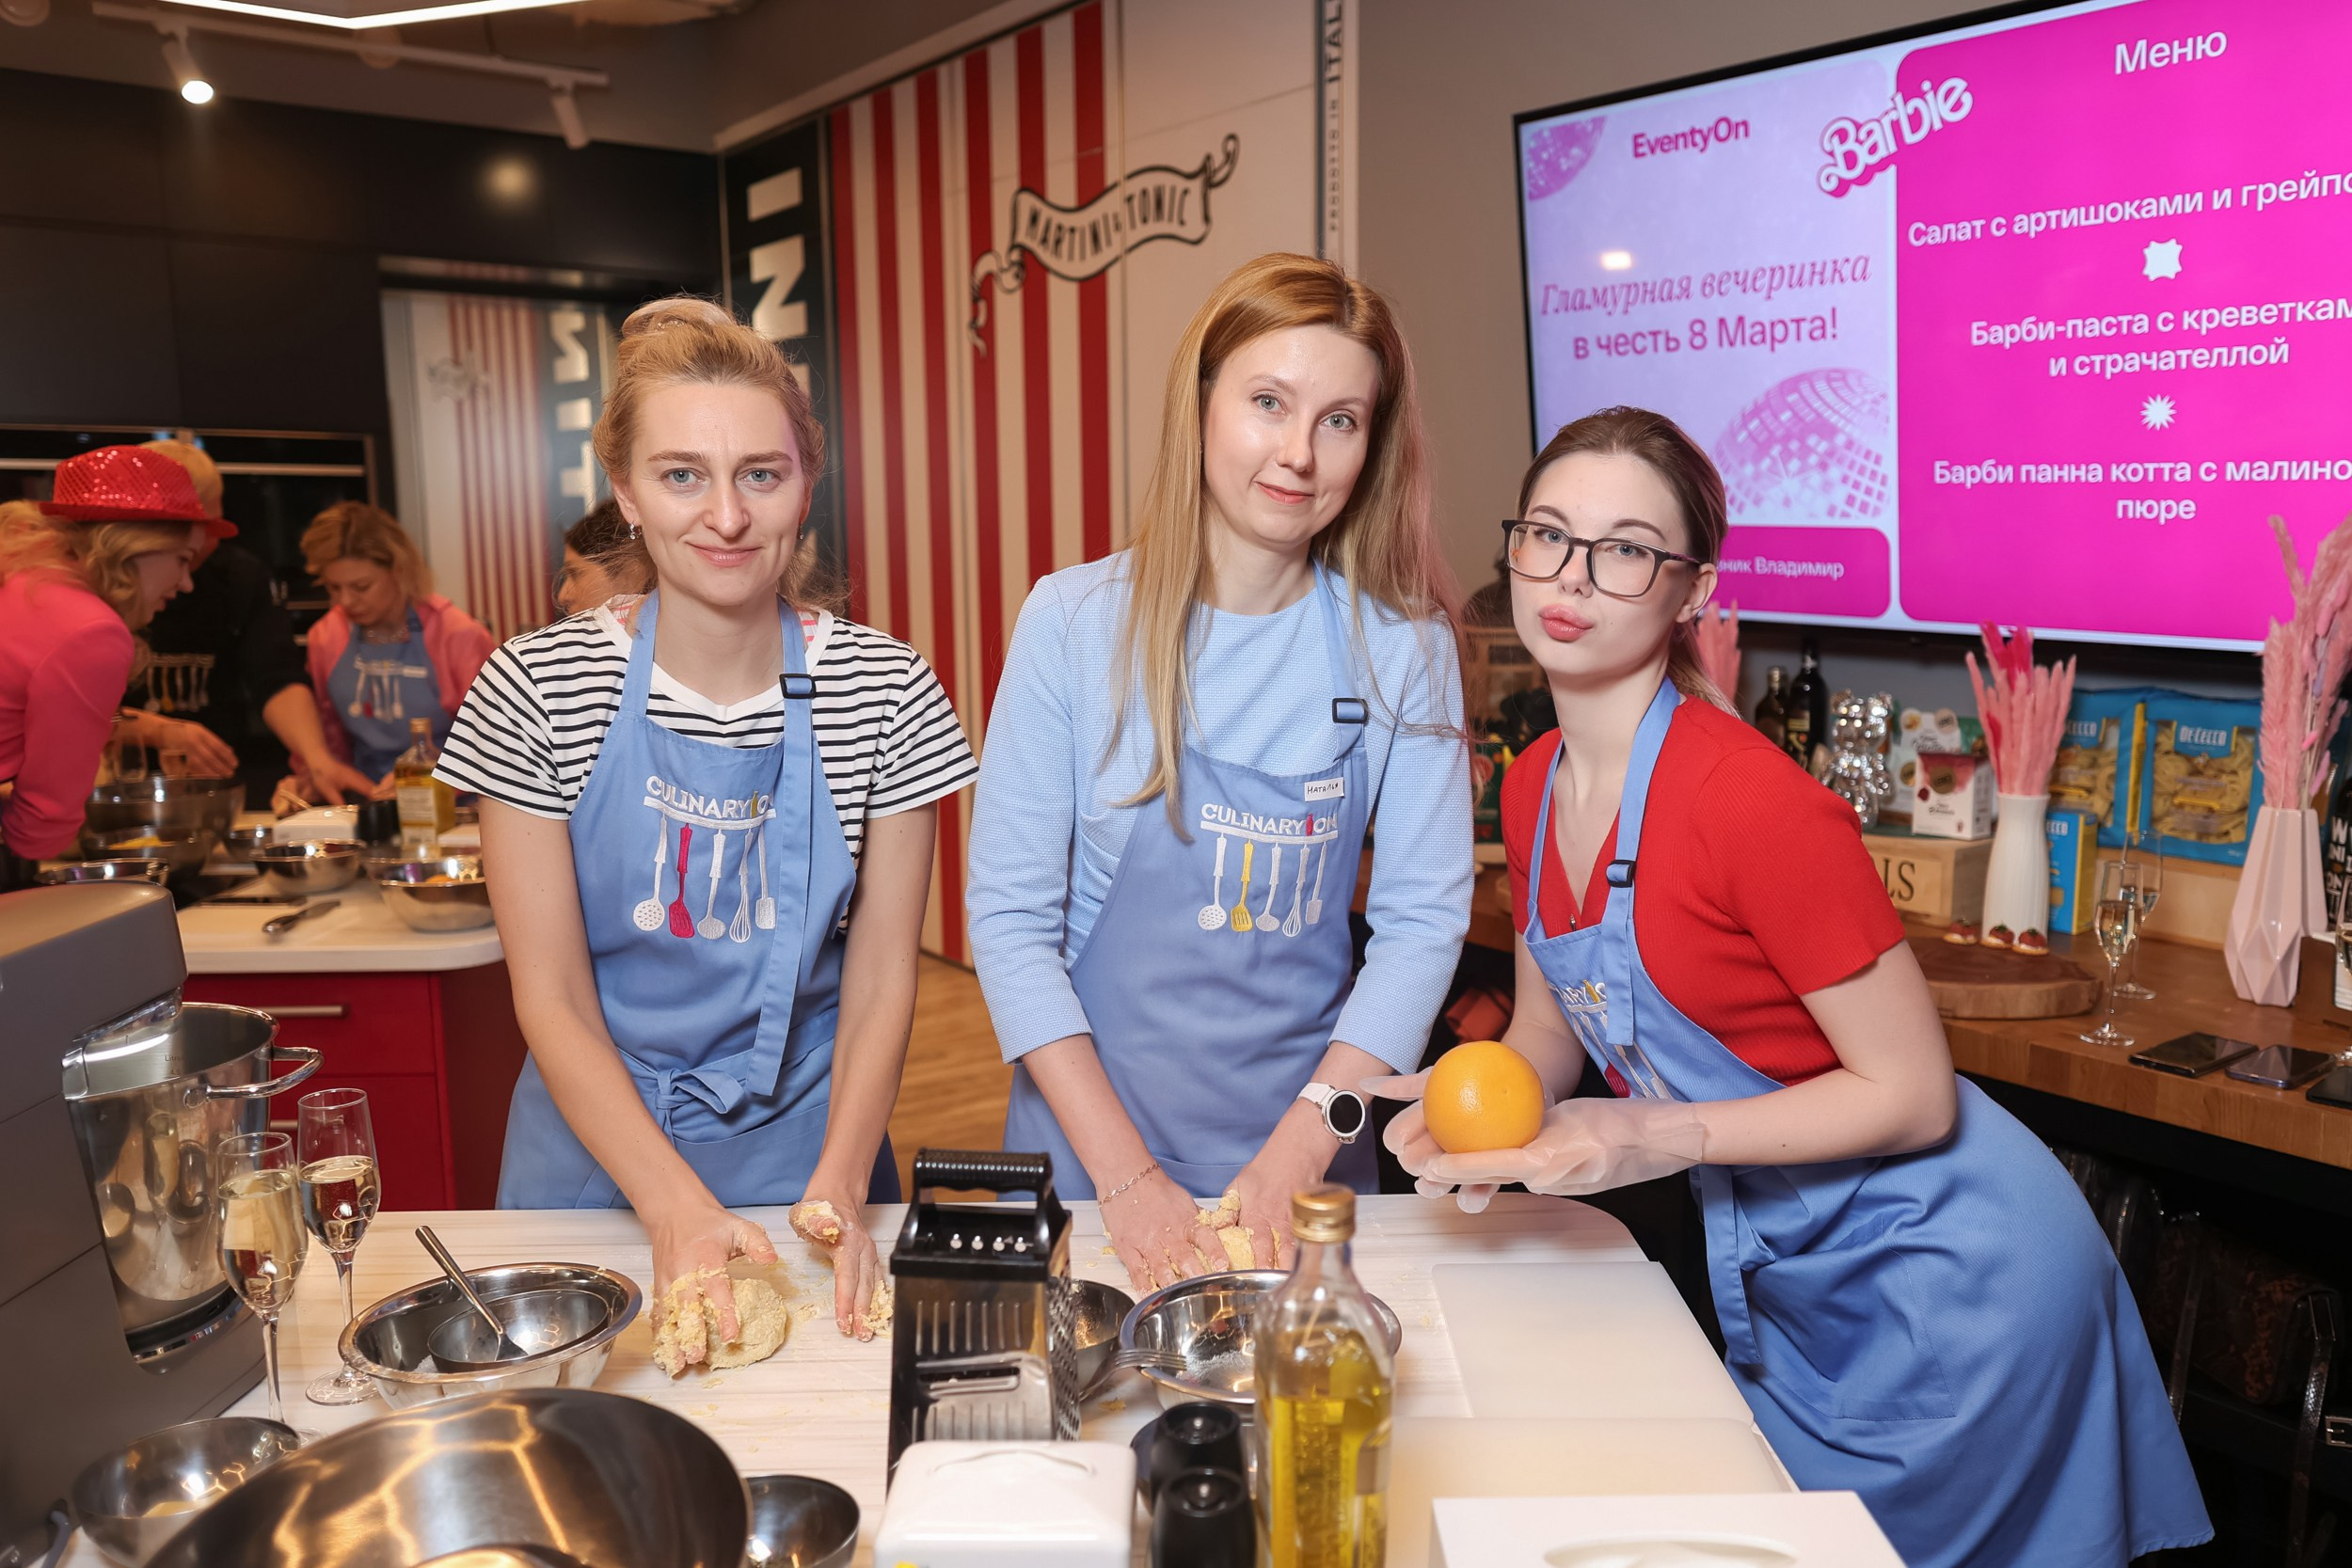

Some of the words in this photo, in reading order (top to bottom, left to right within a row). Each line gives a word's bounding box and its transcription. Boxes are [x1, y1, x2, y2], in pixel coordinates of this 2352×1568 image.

[1325, 0, 1342, 84] ITAL
[2115, 31, 2227, 75] Меню
[1632, 117, 1750, 158] EventyOn
[1819, 76, 1974, 193] Barbie
[1026, 206, 1112, 262] MARTINI
[1124, 184, 1190, 230] TONIC
[1908, 218, 1986, 247] Салат
[1990, 216, 2008, 237] с
[2011, 191, 2203, 239] артишоками
[2213, 187, 2233, 211] и
[1541, 273, 1693, 316] Гламурная
[1700, 255, 1871, 301] вечеринка
[1573, 336, 1590, 360] в
[1597, 329, 1680, 357] честь
[1688, 318, 1708, 351] 8
[1717, 307, 1838, 354] Марта!
[1971, 312, 2150, 350] Барби-паста
[2156, 310, 2175, 333] с
[2049, 356, 2068, 377] и
[2074, 336, 2290, 381] страчателлой
[1933, 458, 2014, 489] Барби
[2020, 462, 2104, 483] панна
[2110, 460, 2192, 483] котта
[2199, 460, 2218, 482] с
[2225, 459, 2352, 482] малино
[2116, 499, 2197, 525] пюре
[1755, 556, 1845, 580] Владимир
